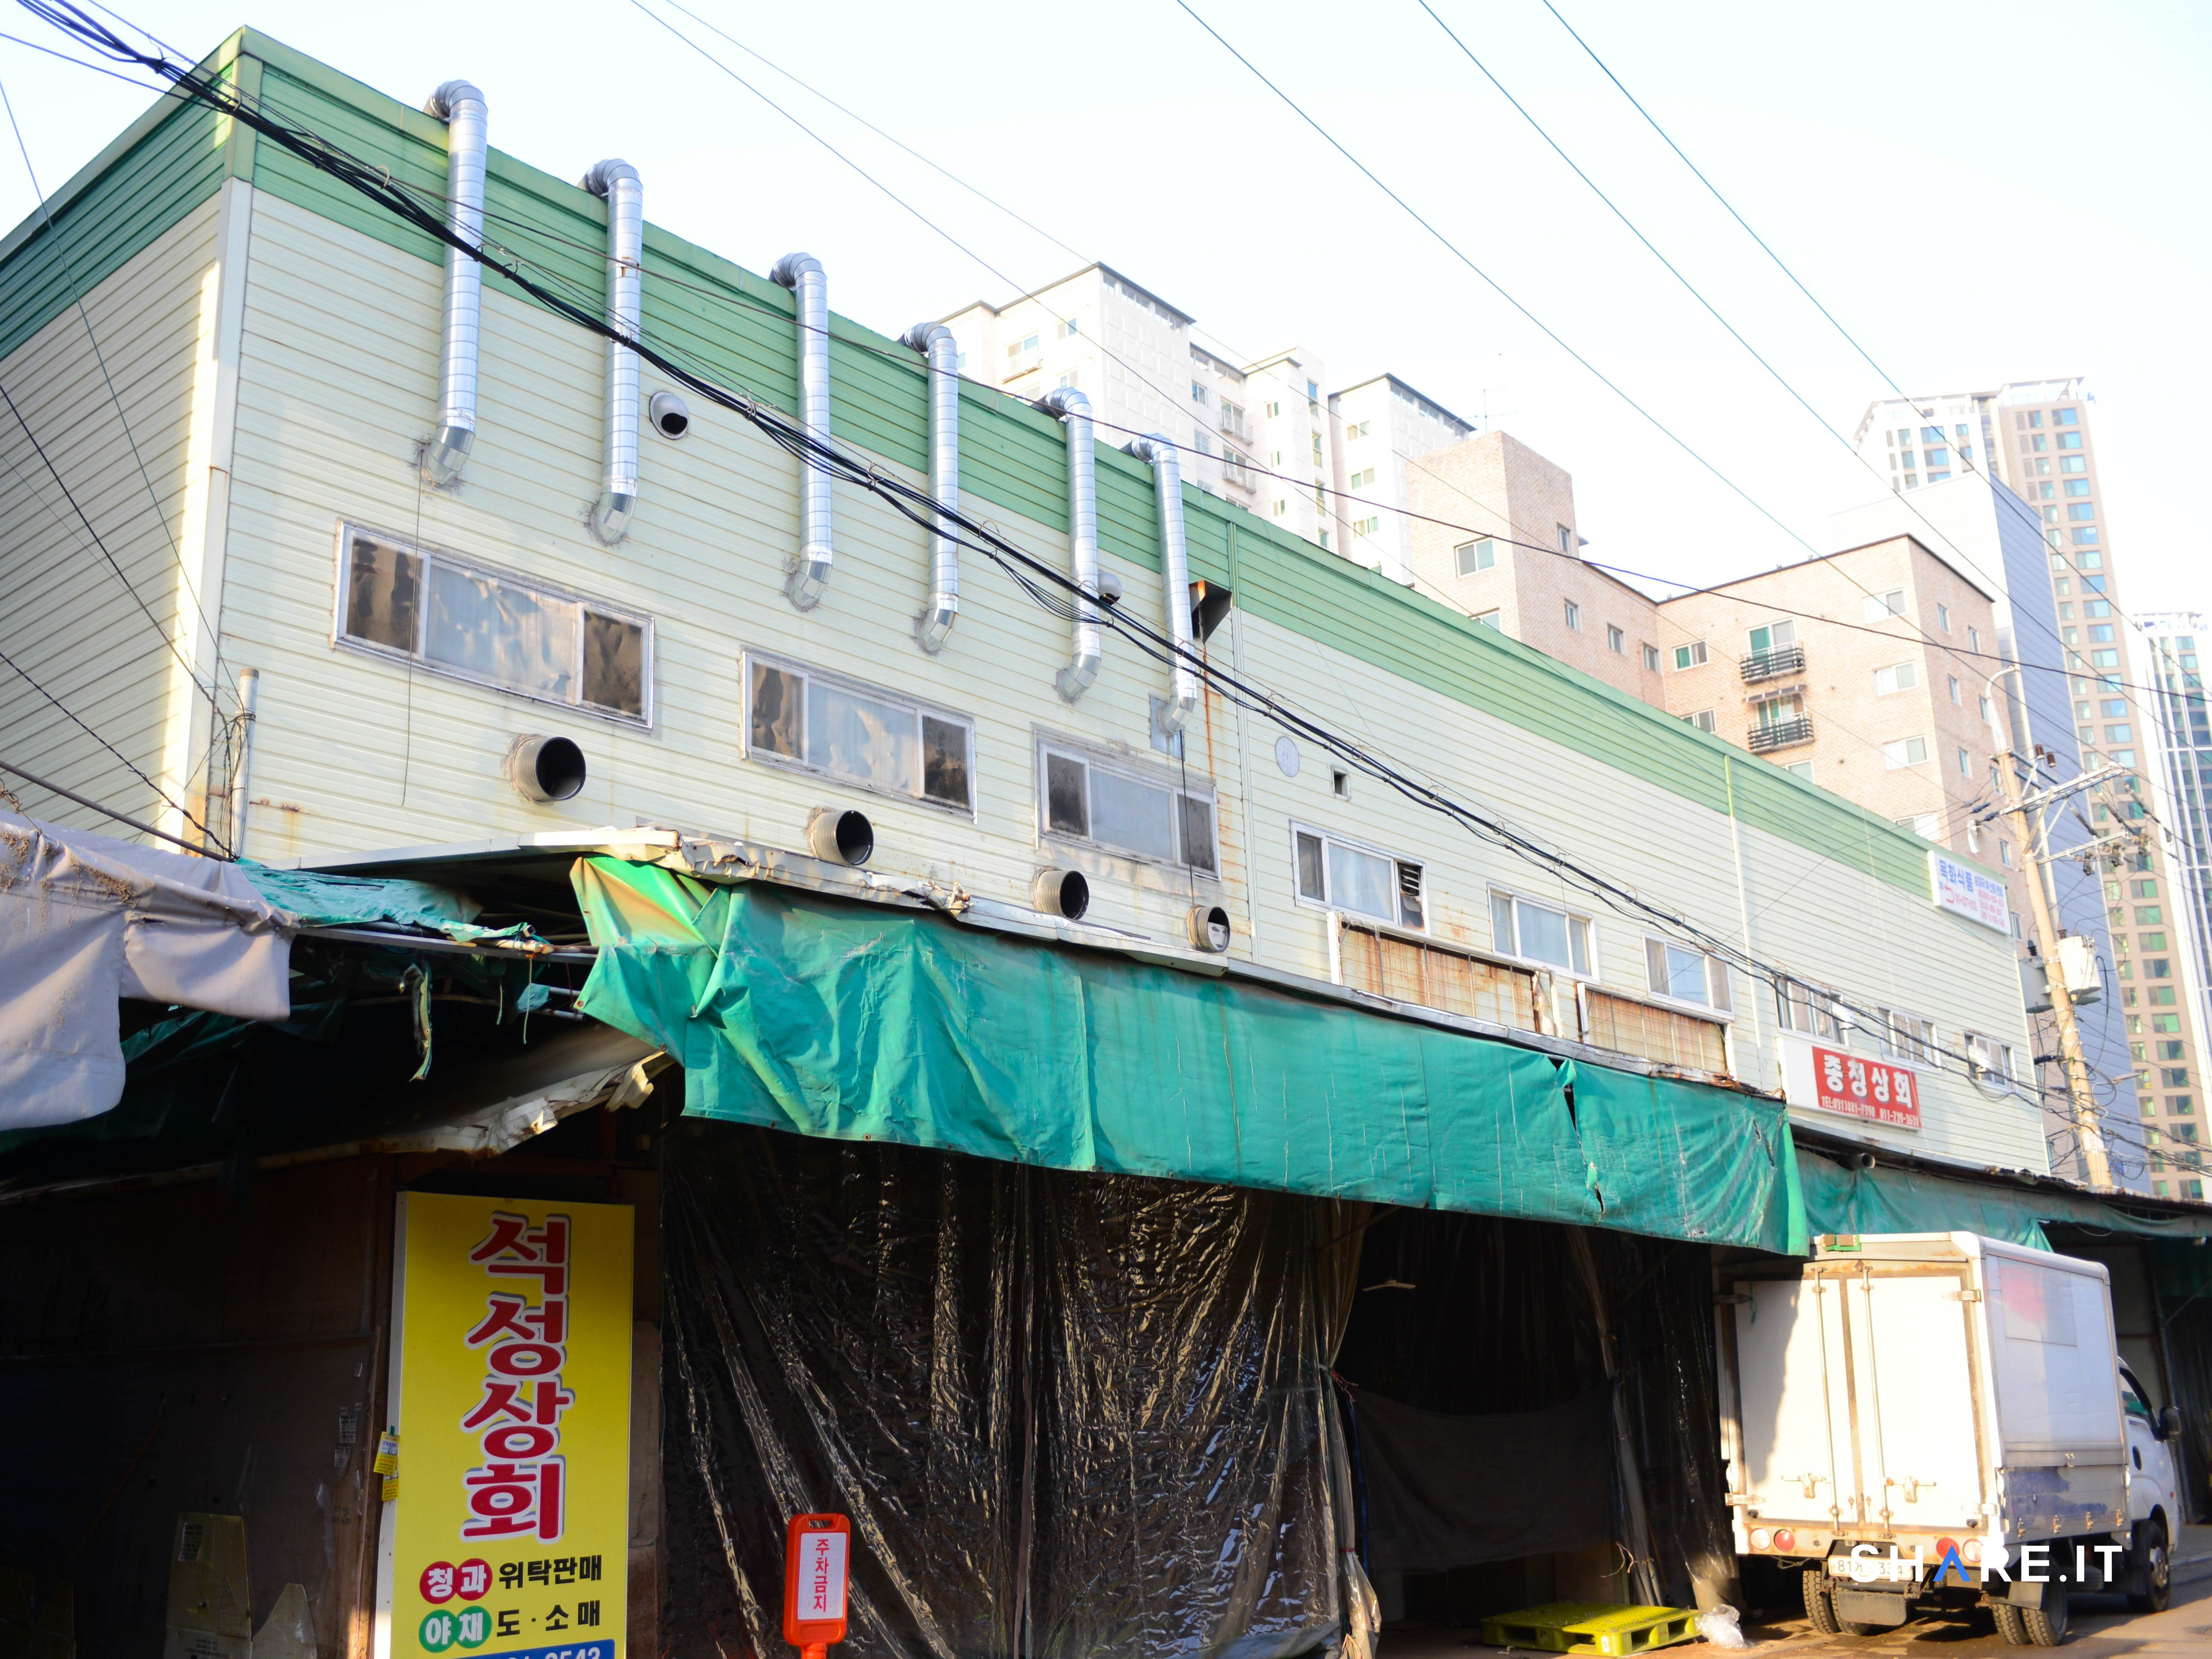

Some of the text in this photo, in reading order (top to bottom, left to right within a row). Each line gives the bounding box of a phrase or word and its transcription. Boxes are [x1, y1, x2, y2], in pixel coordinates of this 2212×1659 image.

[1824, 1055, 1913, 1109] 충청상회
[462, 1214, 573, 1542] 석성상회
[428, 1555, 602, 1597] 청과 위탁판매
[814, 1539, 829, 1612] 주차금지
[425, 1612, 483, 1645] 야채
